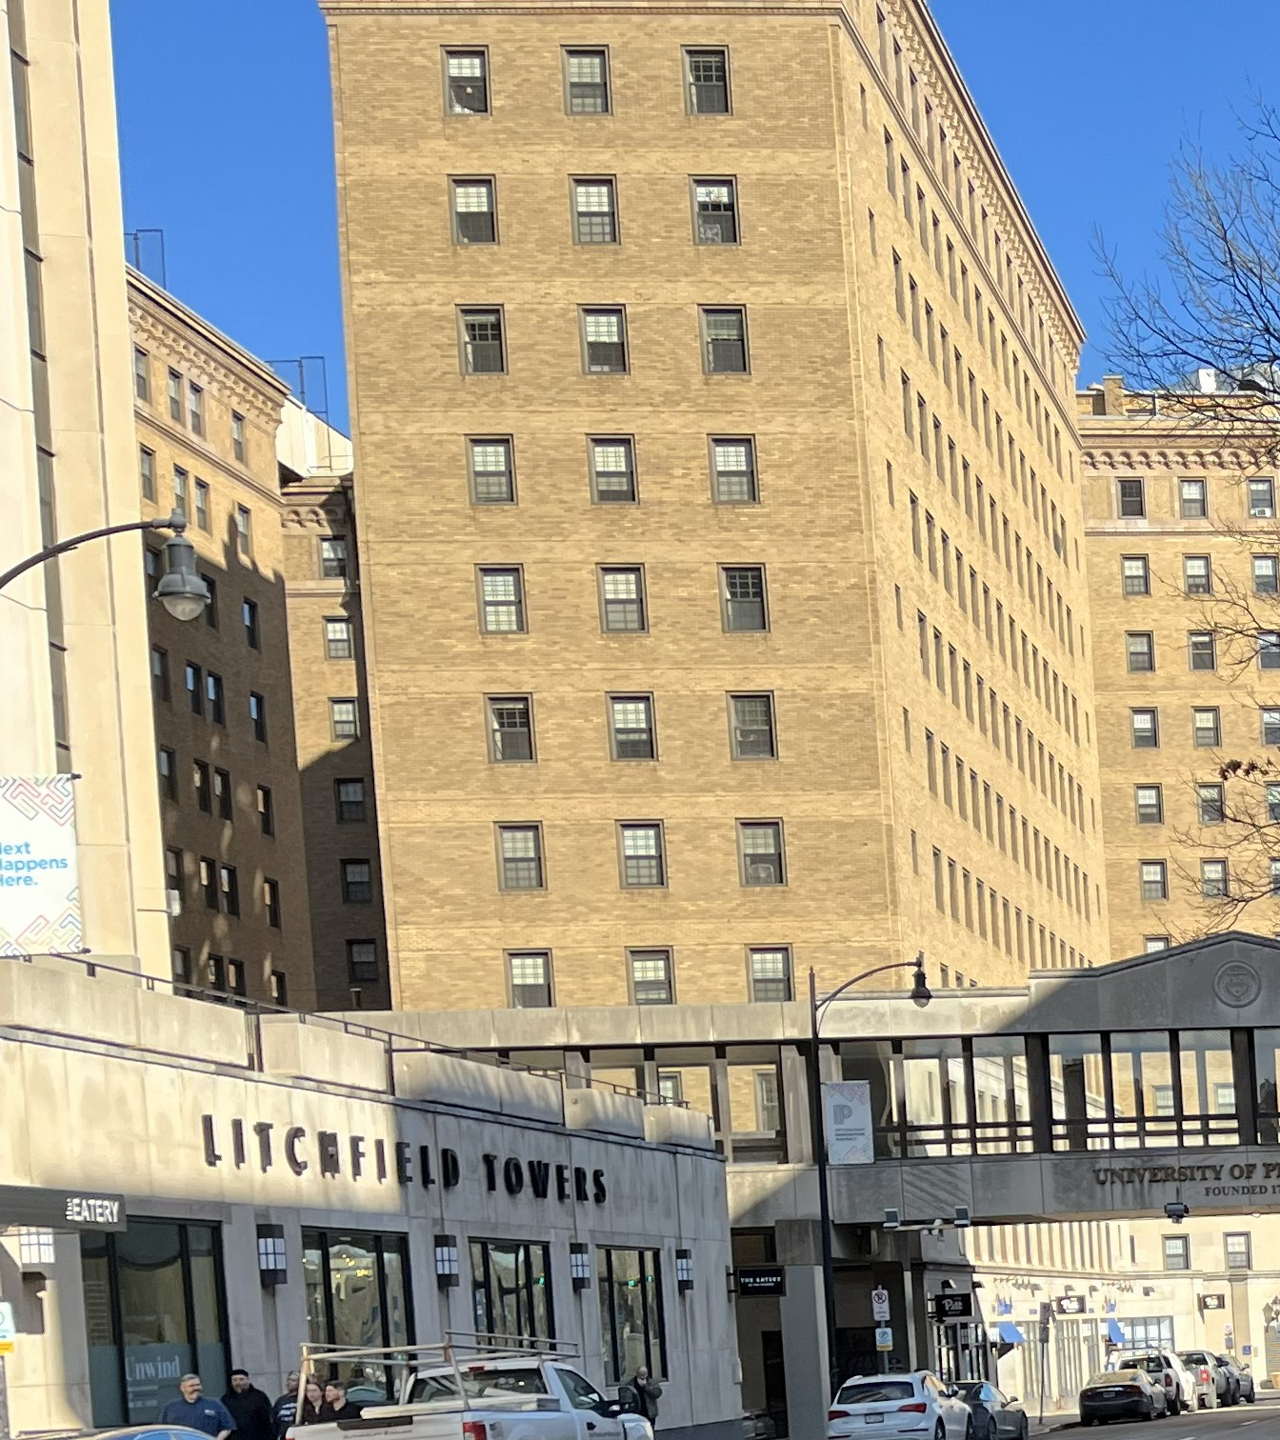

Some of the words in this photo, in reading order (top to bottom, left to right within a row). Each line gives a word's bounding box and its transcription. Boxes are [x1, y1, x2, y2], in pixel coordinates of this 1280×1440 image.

[201, 1114, 460, 1189] LITCHFIELD
[483, 1153, 607, 1204] TOWERS
[1093, 1164, 1225, 1185] UNIVERSITY
[1230, 1162, 1257, 1180] OF
[1204, 1185, 1268, 1197] FOUNDED
[72, 1198, 119, 1223] EATERY
[125, 1354, 181, 1381] Unwind
